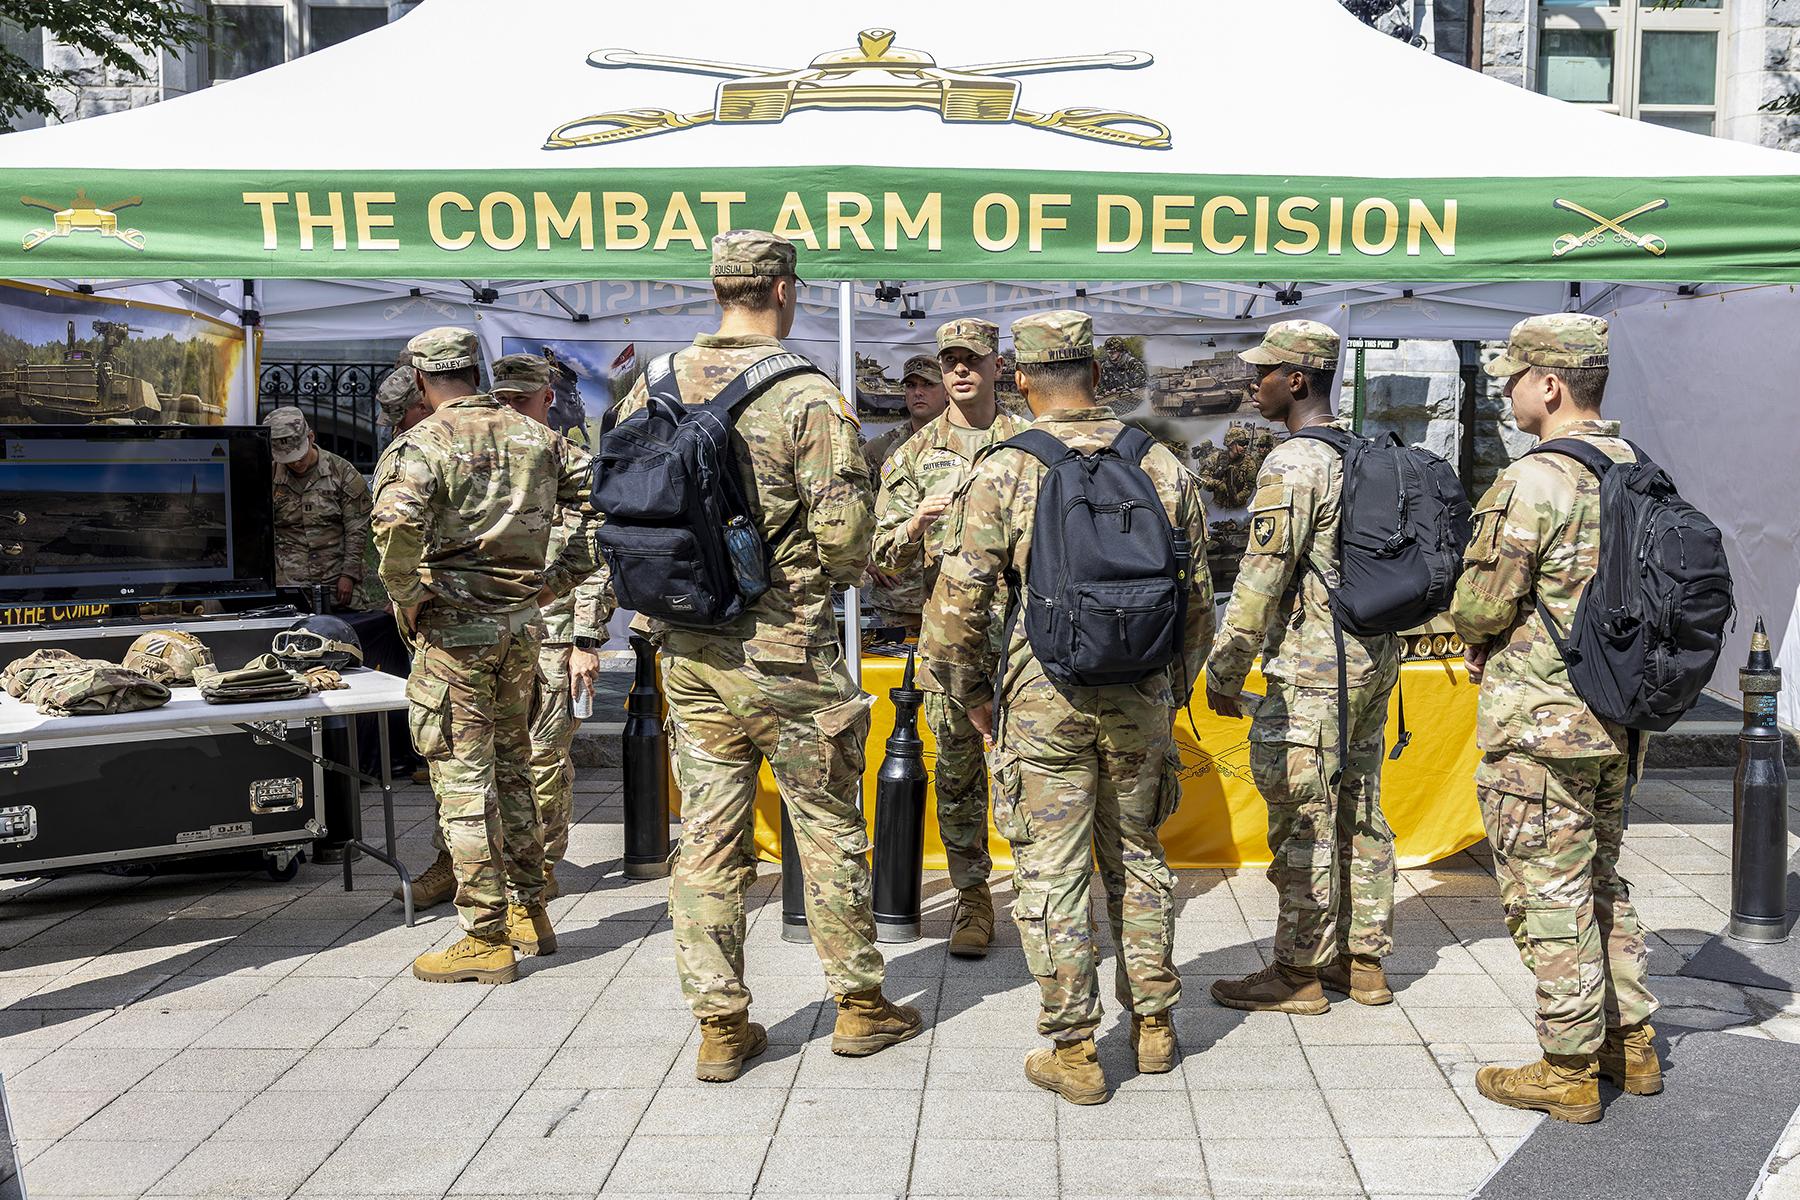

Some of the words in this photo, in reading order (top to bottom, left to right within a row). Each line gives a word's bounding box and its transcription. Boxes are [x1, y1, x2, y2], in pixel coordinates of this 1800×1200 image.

[242, 191, 400, 251] THE
[427, 191, 746, 251] COMBAT
[770, 191, 942, 252] ARM
[973, 192, 1073, 253] OF
[1096, 194, 1458, 256] DECISION
[715, 264, 741, 274] BOUSUM
[1347, 340, 1364, 348] EYOND
[1364, 340, 1377, 348] THIS
[1377, 340, 1394, 348] POINT
[1047, 346, 1088, 360] WILLIAMS
[435, 360, 461, 370] DALEY
[923, 459, 956, 471] GUTIERREZ
[217, 824, 243, 832] DJK
